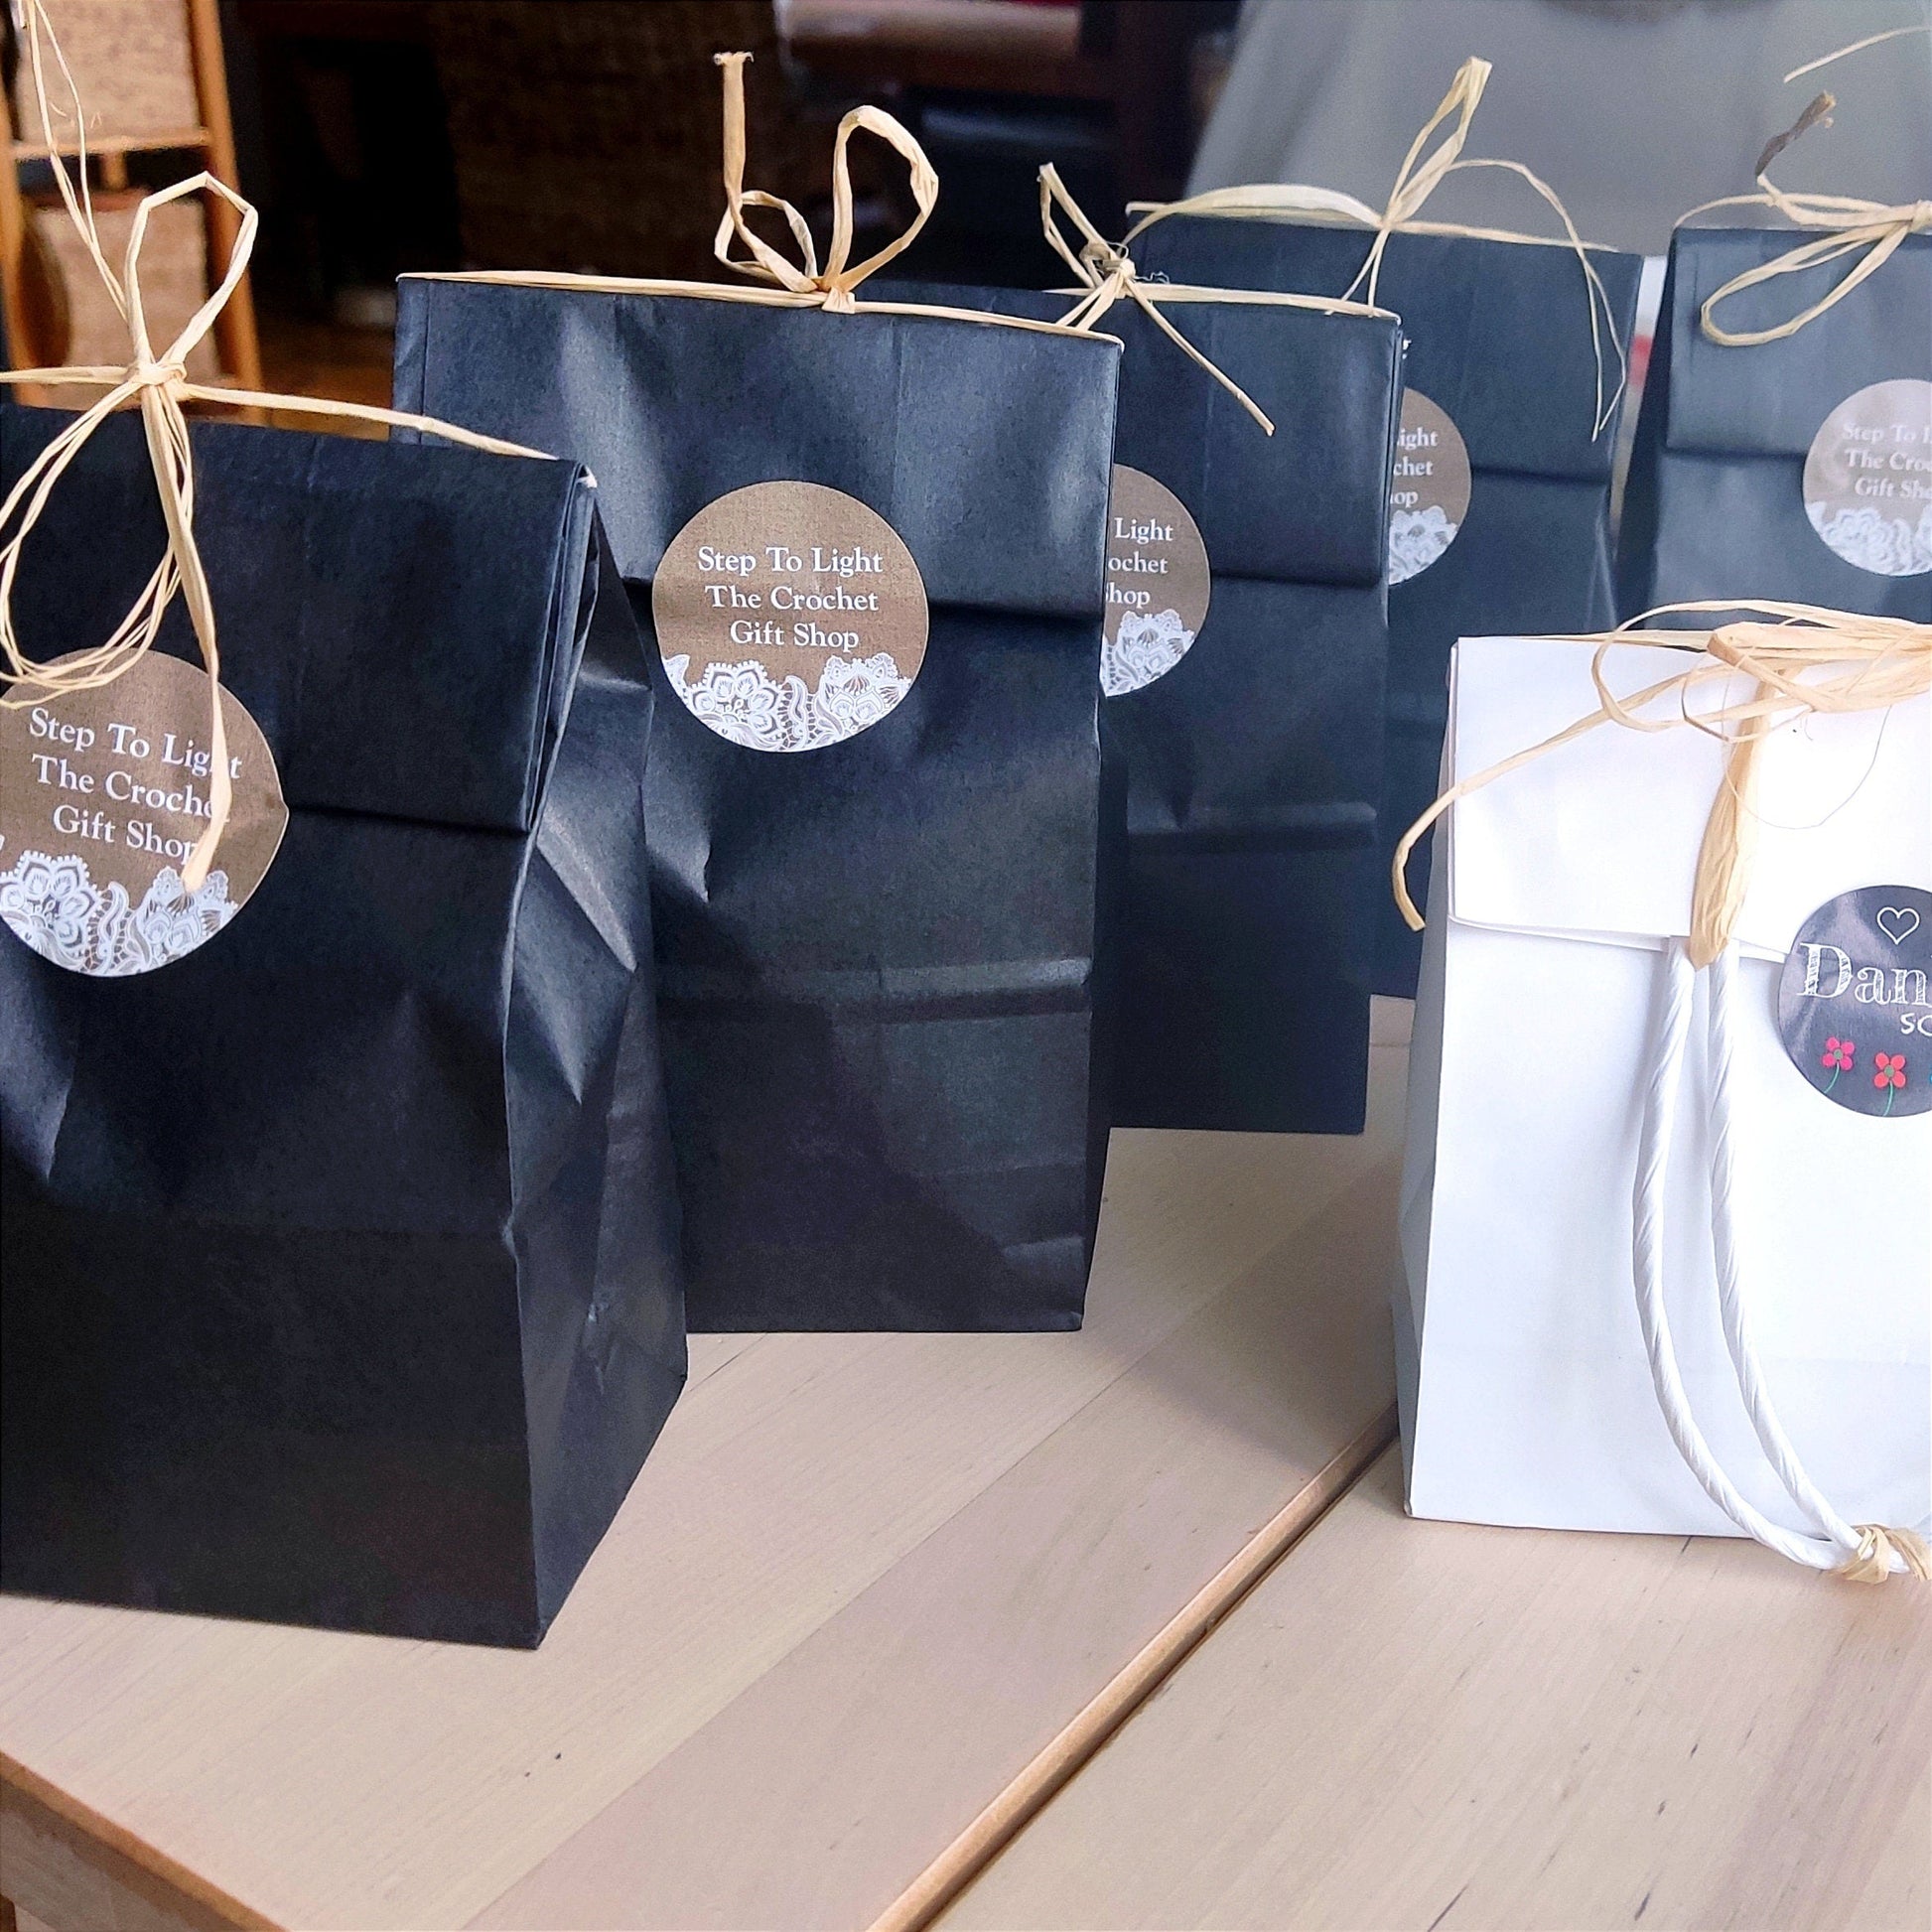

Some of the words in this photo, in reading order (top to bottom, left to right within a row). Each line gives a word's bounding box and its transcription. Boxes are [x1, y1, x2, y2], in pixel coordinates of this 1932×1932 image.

[1397, 427, 1439, 451] ight
[1843, 422, 1884, 445] Step
[1890, 424, 1916, 443] To
[1393, 456, 1434, 476] chet
[1844, 449, 1883, 470] The
[1855, 478, 1894, 496] Gift
[1114, 517, 1173, 545] Light
[698, 545, 757, 577] Step
[765, 546, 802, 573] To
[810, 546, 884, 577] Light
[1108, 551, 1169, 574] ochet
[705, 585, 761, 609] The
[769, 586, 880, 612] Crochet
[1106, 582, 1151, 610] hop
[730, 620, 784, 646] Gift
[793, 622, 859, 652] Shop
[29, 707, 95, 753] Step
[107, 723, 151, 759] To
[162, 733, 243, 780] Ligt
[31, 753, 95, 793] The
[53, 804, 116, 844] Gift
[1797, 942, 1932, 1009] Dan
